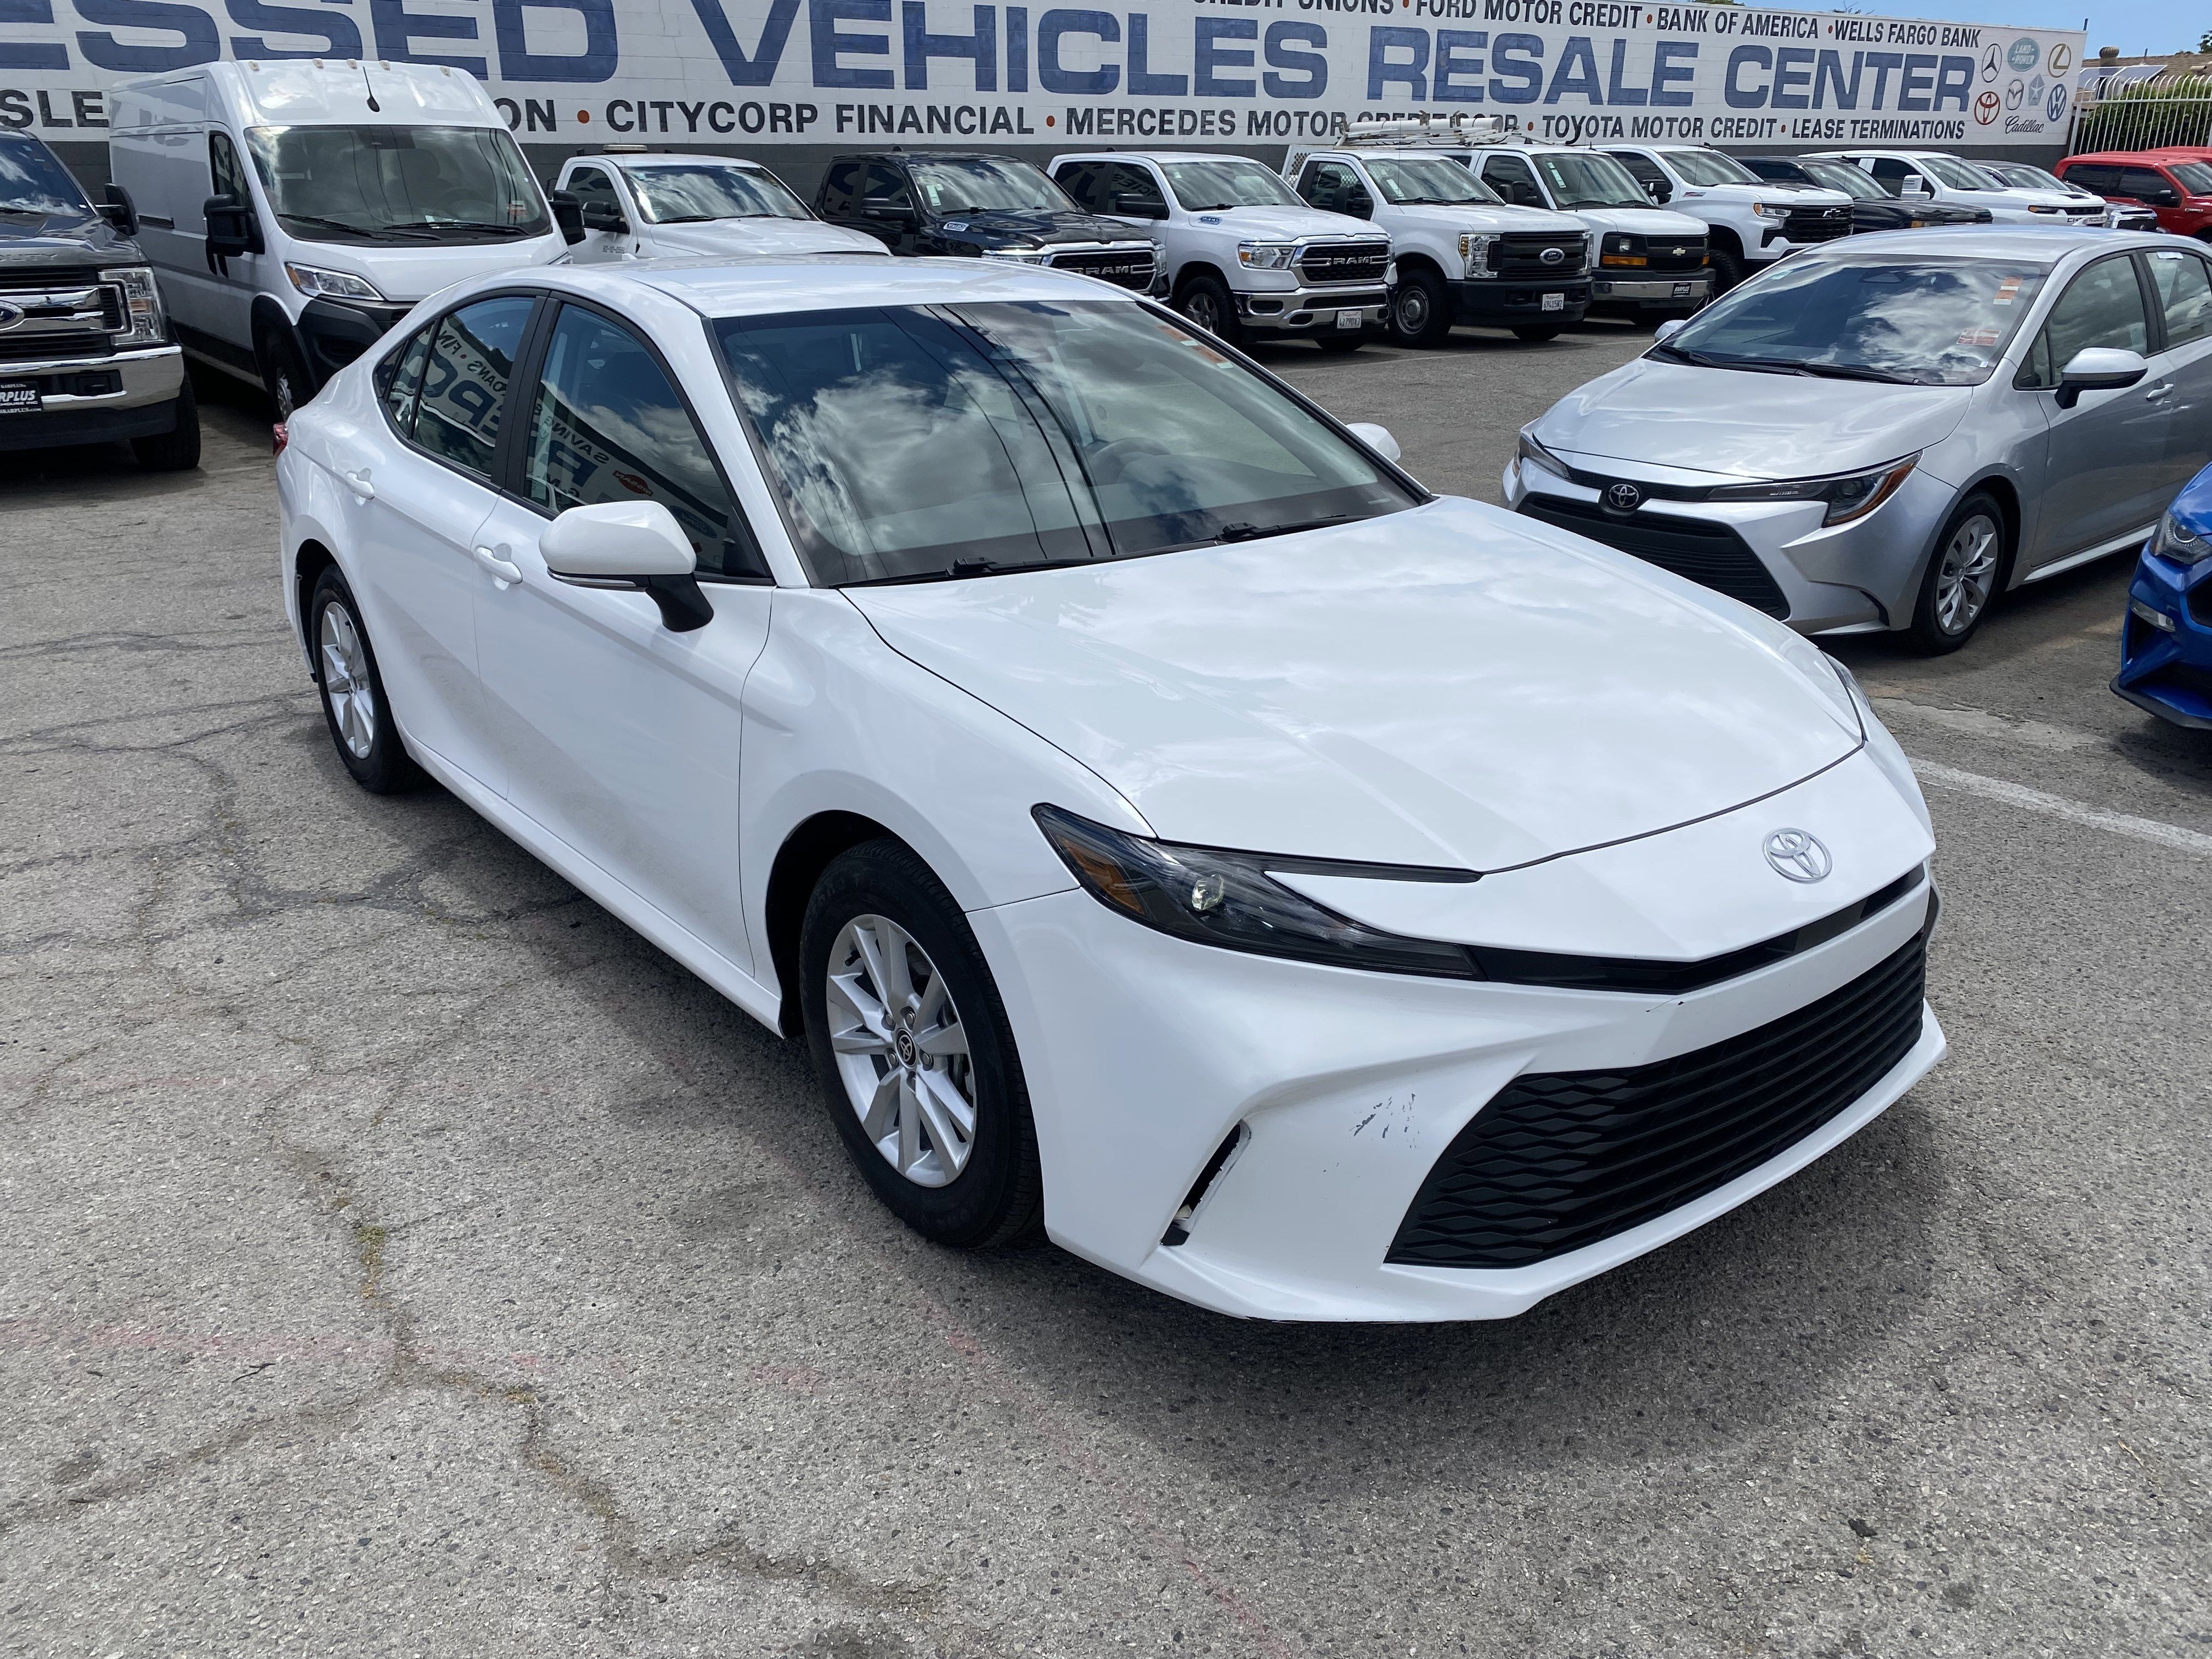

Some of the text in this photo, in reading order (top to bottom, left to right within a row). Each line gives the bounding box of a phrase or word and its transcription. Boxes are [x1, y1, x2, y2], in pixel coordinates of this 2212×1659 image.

[1417, 0, 1476, 18] FORD
[1484, 0, 1562, 25] MOTOR
[1569, 2, 1643, 29] CREDIT
[1657, 9, 1710, 32] BANK
[1715, 13, 1739, 34] OF
[1741, 15, 1819, 39] AMERICA
[1834, 21, 1883, 42] WELLS
[1887, 24, 1937, 46] FARGO
[1940, 27, 1982, 48] BANK
[690, 0, 1328, 99] VEHICLES
[1367, 26, 1700, 107] RESALE
[1724, 45, 1976, 112] CENTER
[2015, 44, 2032, 54] LAND
[606, 99, 818, 134] CITYCORP
[836, 104, 1034, 135] FINANCIAL
[1066, 108, 1236, 136] MERCEDES
[1248, 110, 1348, 138] MOTOR
[1542, 115, 1623, 139] TOYOTA
[1630, 116, 1704, 139] MOTOR
[1711, 117, 1777, 139] CREDIT
[1792, 118, 1846, 139] LEASE
[1850, 119, 1965, 139] TERMINATIONS
[2005, 115, 2044, 134] Cadillac
[1085, 266, 1129, 275] RAM
[1333, 256, 1370, 265] RAM
